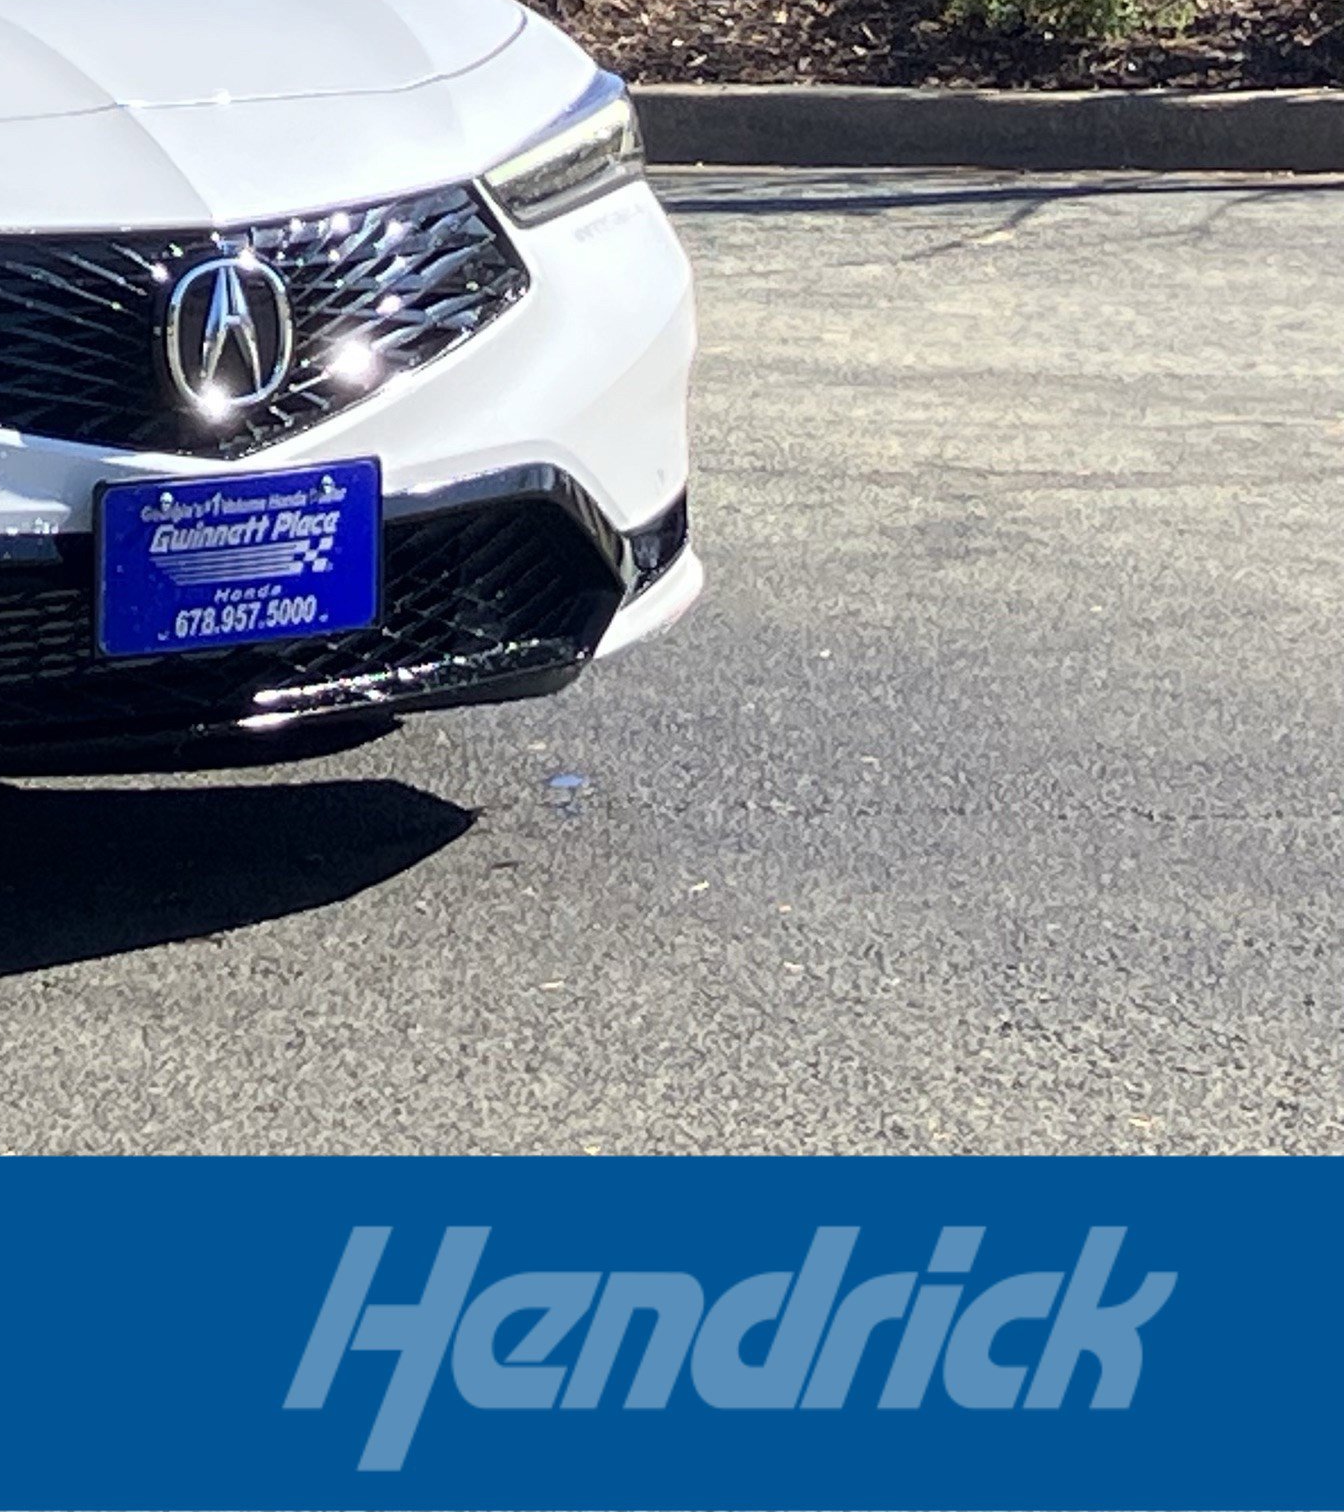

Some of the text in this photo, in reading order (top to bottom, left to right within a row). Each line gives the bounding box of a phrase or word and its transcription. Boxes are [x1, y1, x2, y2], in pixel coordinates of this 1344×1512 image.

[149, 510, 340, 553] Gwinnett Place
[214, 583, 282, 604] Honda
[175, 594, 317, 638] 678.957.5000
